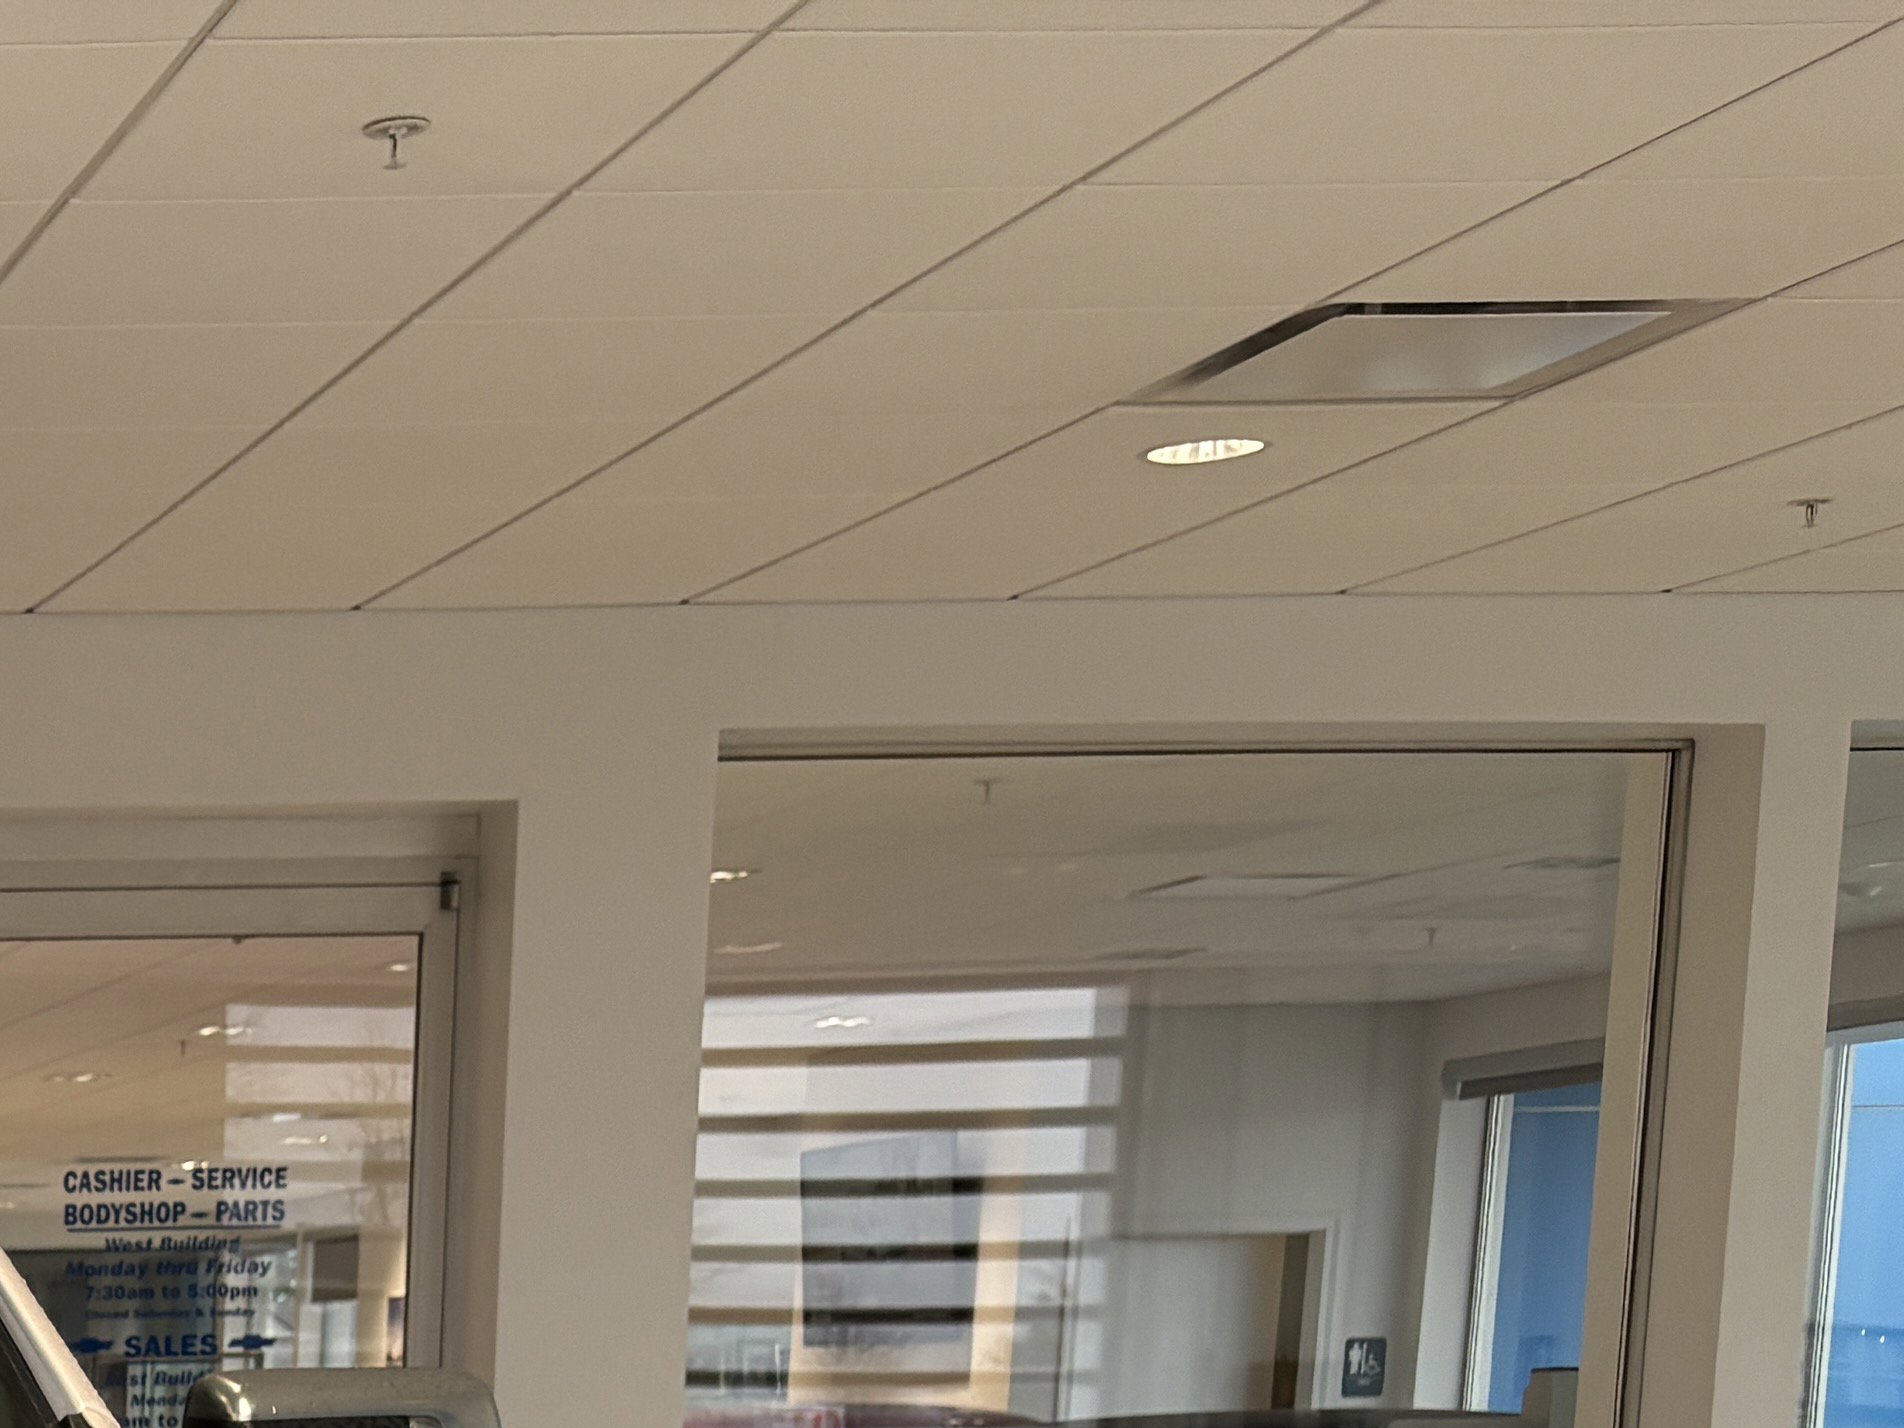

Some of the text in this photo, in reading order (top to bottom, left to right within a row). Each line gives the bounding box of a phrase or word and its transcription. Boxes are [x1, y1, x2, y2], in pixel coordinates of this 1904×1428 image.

[63, 1169, 162, 1193] CASHIER
[191, 1166, 289, 1190] SERVICE
[64, 1201, 186, 1226] BODYSHOP
[215, 1199, 286, 1223] PARTS
[105, 1235, 240, 1254] West Building
[65, 1257, 273, 1279] Monday thru Friday
[162, 1285, 181, 1299] to
[125, 1333, 218, 1357] SALES
